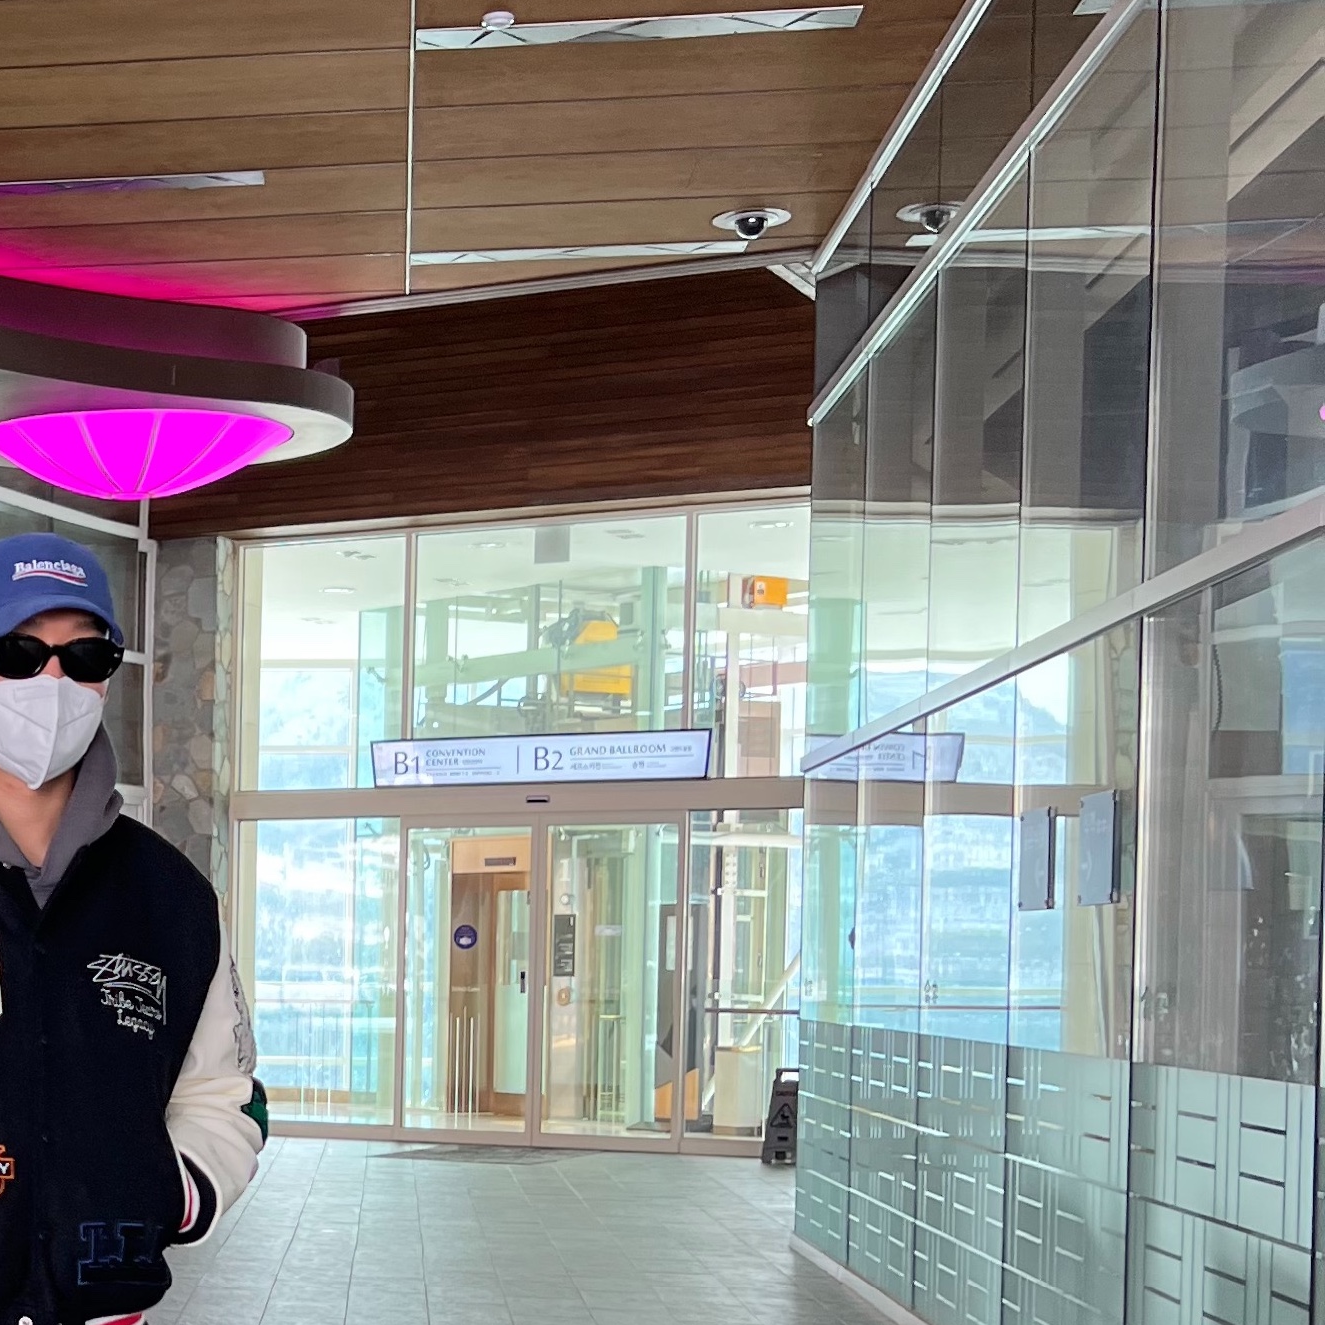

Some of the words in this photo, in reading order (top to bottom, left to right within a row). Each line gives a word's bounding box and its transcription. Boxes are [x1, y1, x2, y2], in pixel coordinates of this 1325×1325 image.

[14, 559, 87, 578] Balenciaga
[425, 748, 486, 757] CONVENTION
[534, 746, 564, 771] B2
[569, 746, 607, 756] GRAND
[609, 744, 666, 755] BALLROOM
[394, 750, 420, 776] B1
[425, 758, 459, 766] CENTER
[116, 1008, 155, 1040] Legacy
